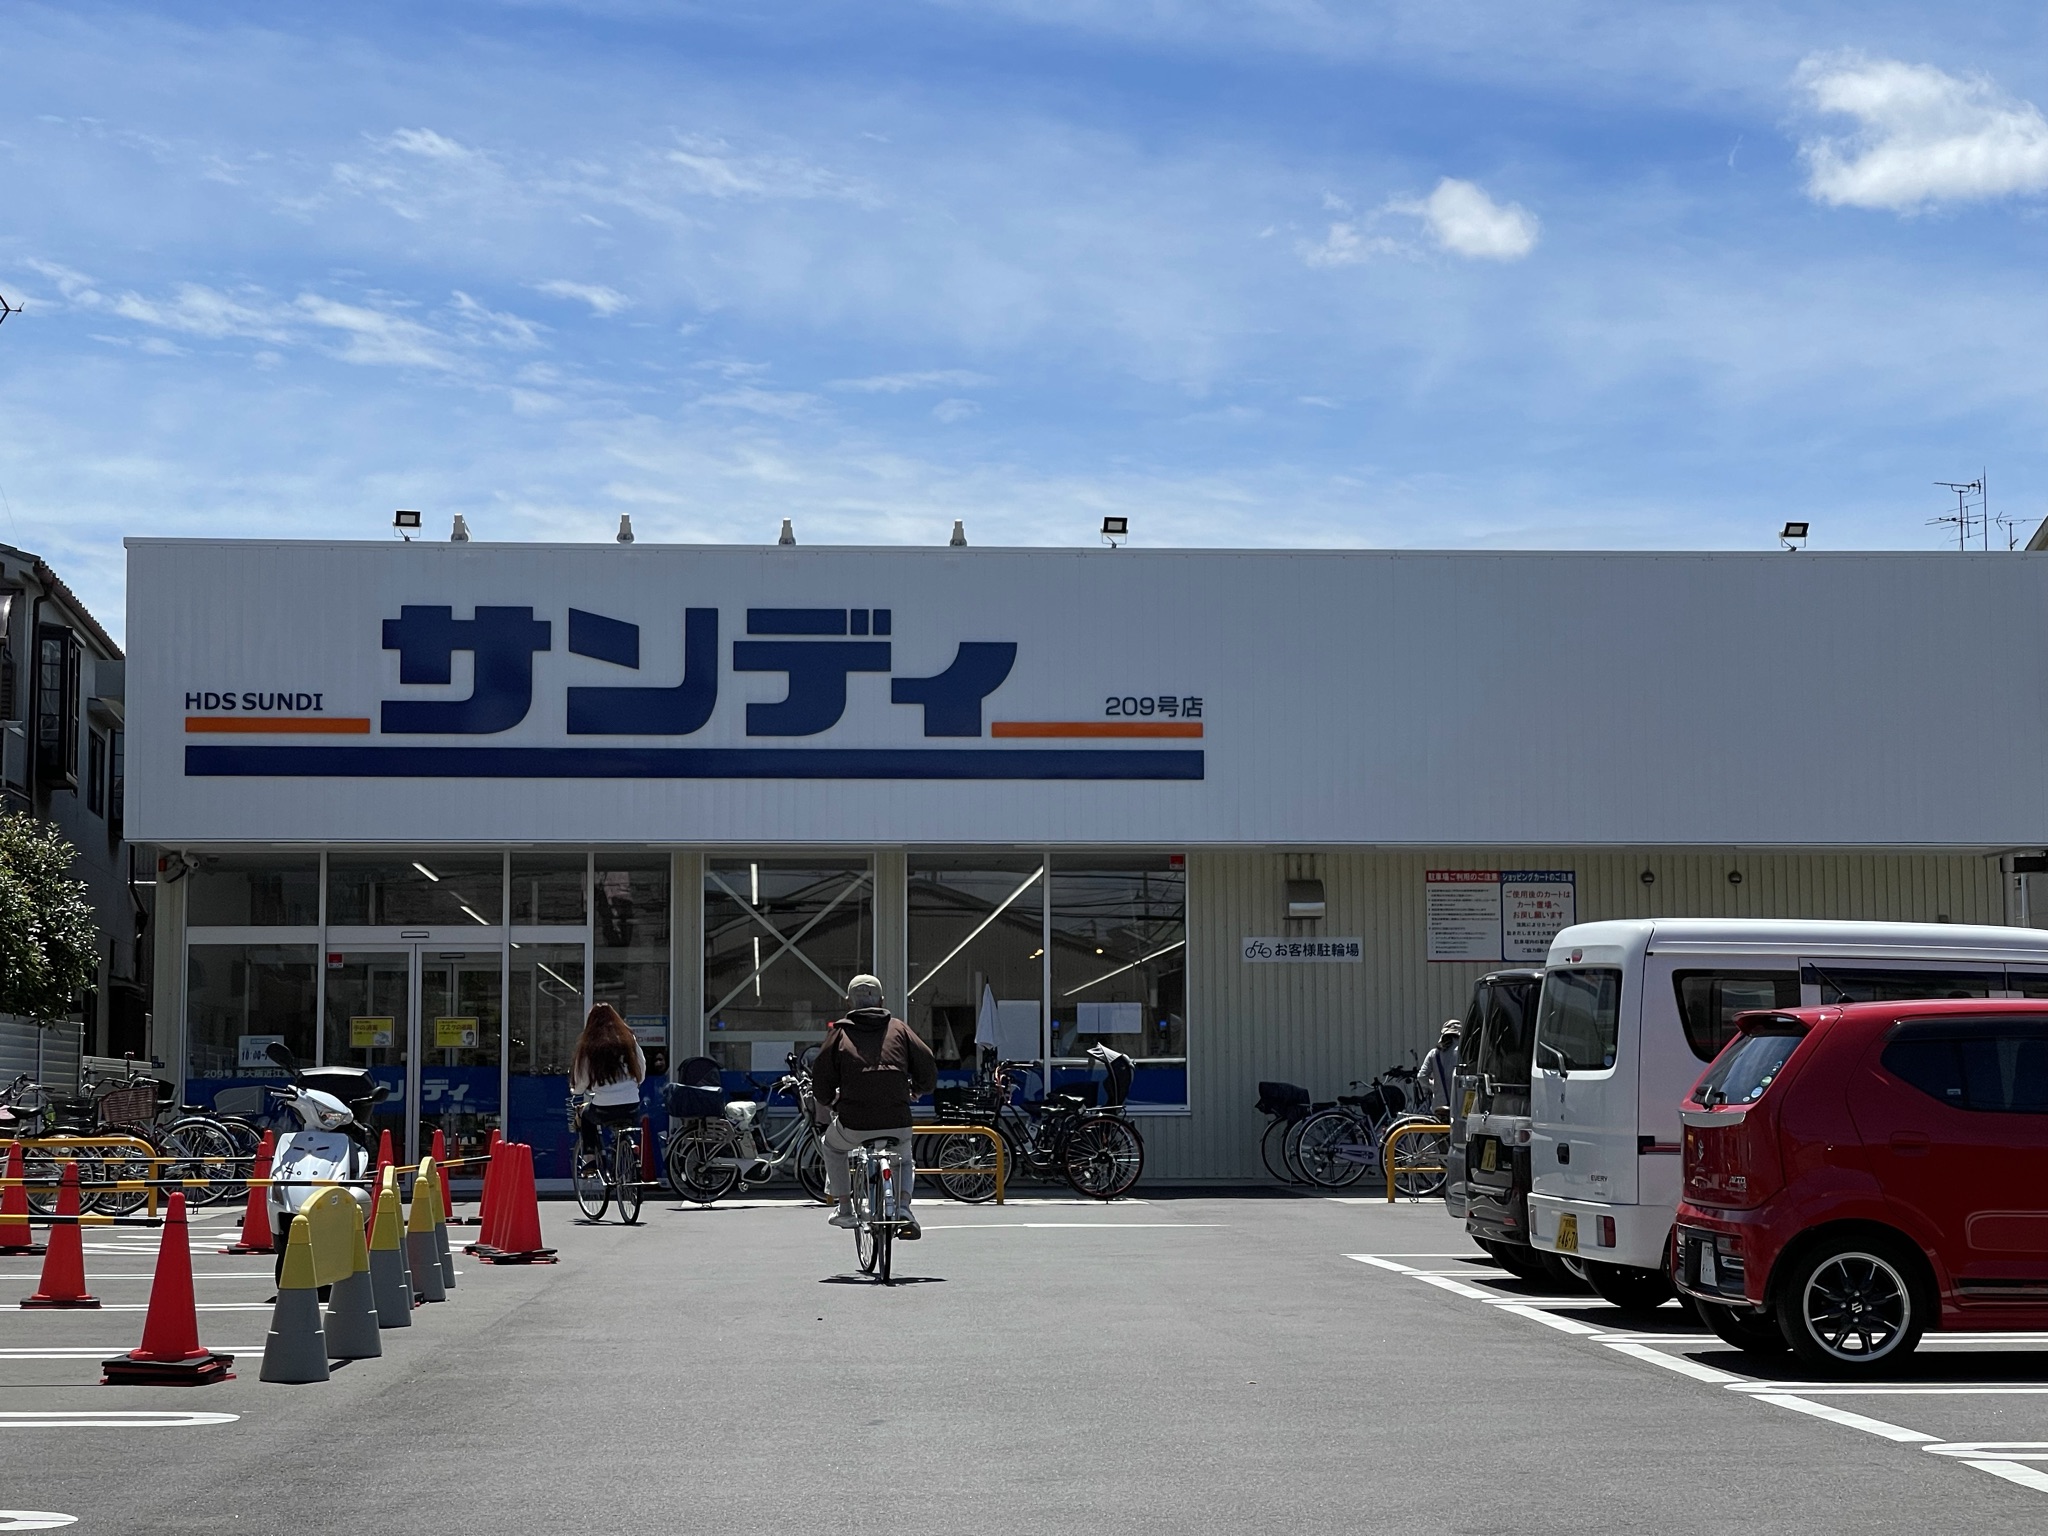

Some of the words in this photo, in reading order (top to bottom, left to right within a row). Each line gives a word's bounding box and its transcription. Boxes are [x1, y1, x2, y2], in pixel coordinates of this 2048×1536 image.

[381, 605, 1018, 738] サンディ
[185, 692, 237, 711] HDS
[241, 693, 324, 712] SUNDI
[1104, 695, 1204, 718] 209号店
[1505, 890, 1571, 899] ご使用後のカートは
[1275, 943, 1360, 957] お客様駐輪場
[203, 1069, 234, 1079] 209号
[374, 1079, 470, 1101] ンディ
